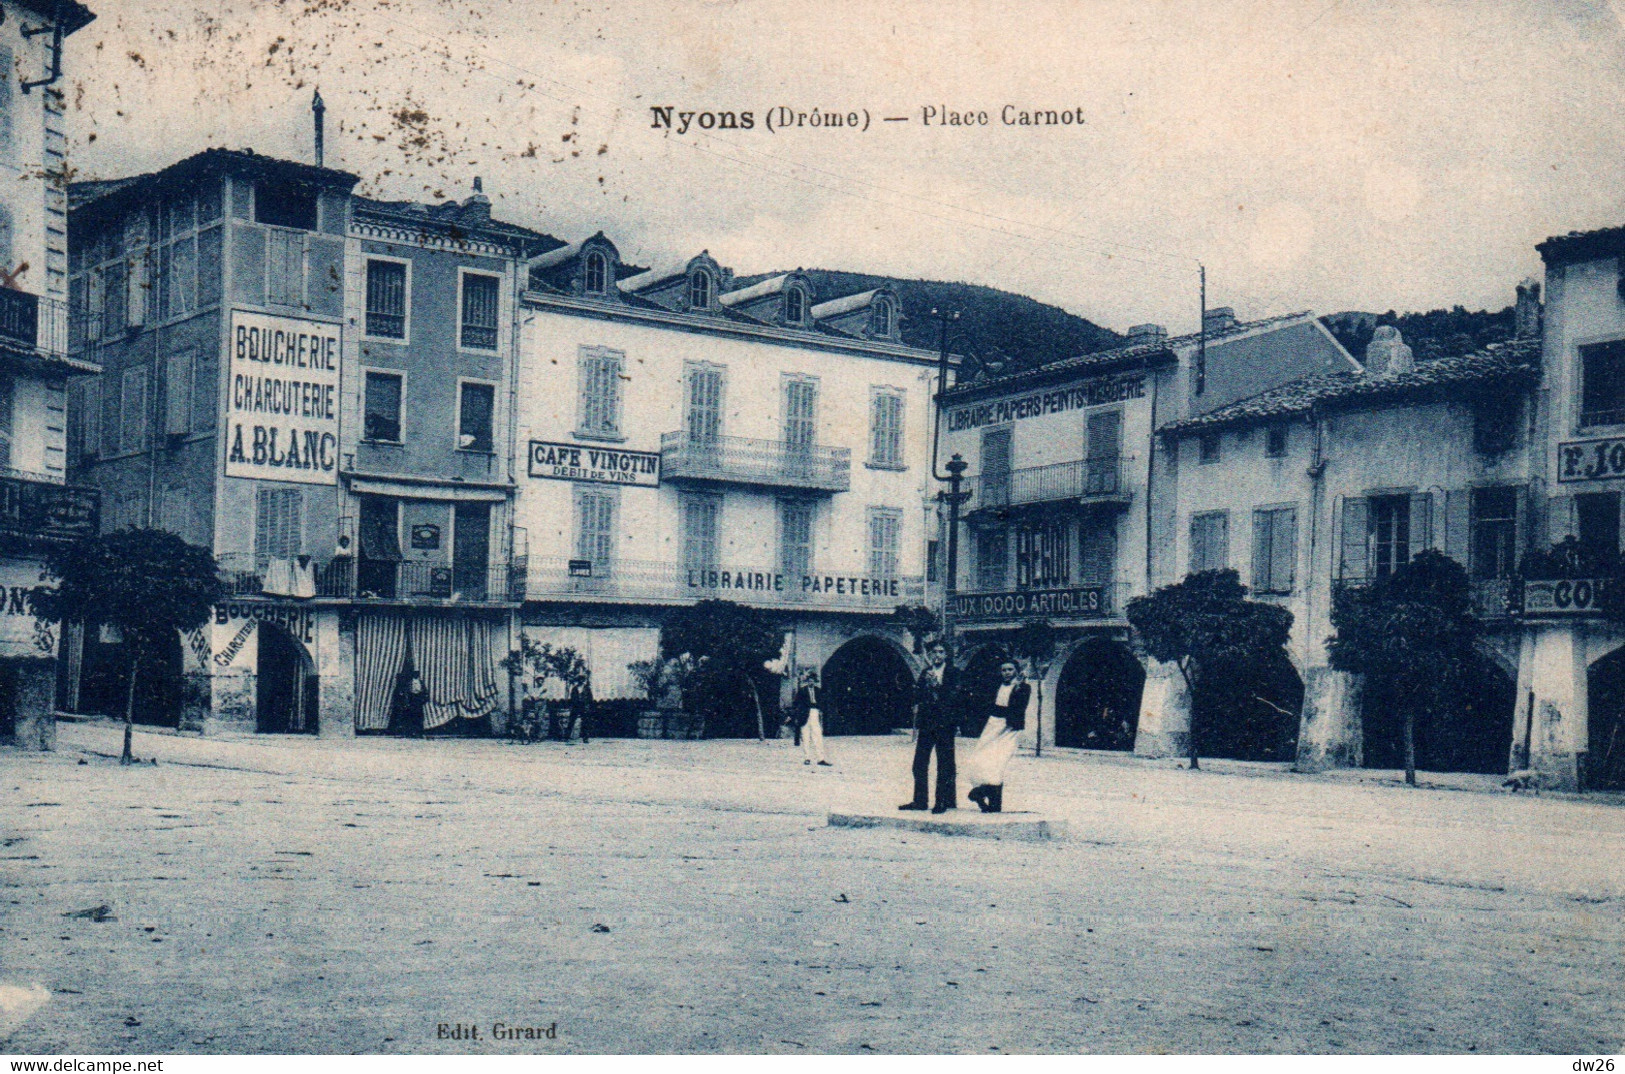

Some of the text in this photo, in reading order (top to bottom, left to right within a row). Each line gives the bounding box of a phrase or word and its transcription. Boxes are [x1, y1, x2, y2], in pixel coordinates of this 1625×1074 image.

[236, 325, 336, 371] BOUCHERIE
[235, 373, 335, 420] CHARCUTERIE
[534, 445, 658, 474] CAFE VINGTIN
[591, 469, 605, 480] DE
[609, 471, 637, 481] VINS
[687, 569, 899, 597] LIBRAIRIE PAPETERIE
[1030, 590, 1098, 613] ARTICLES
[214, 602, 315, 644] BOUCHERIE
